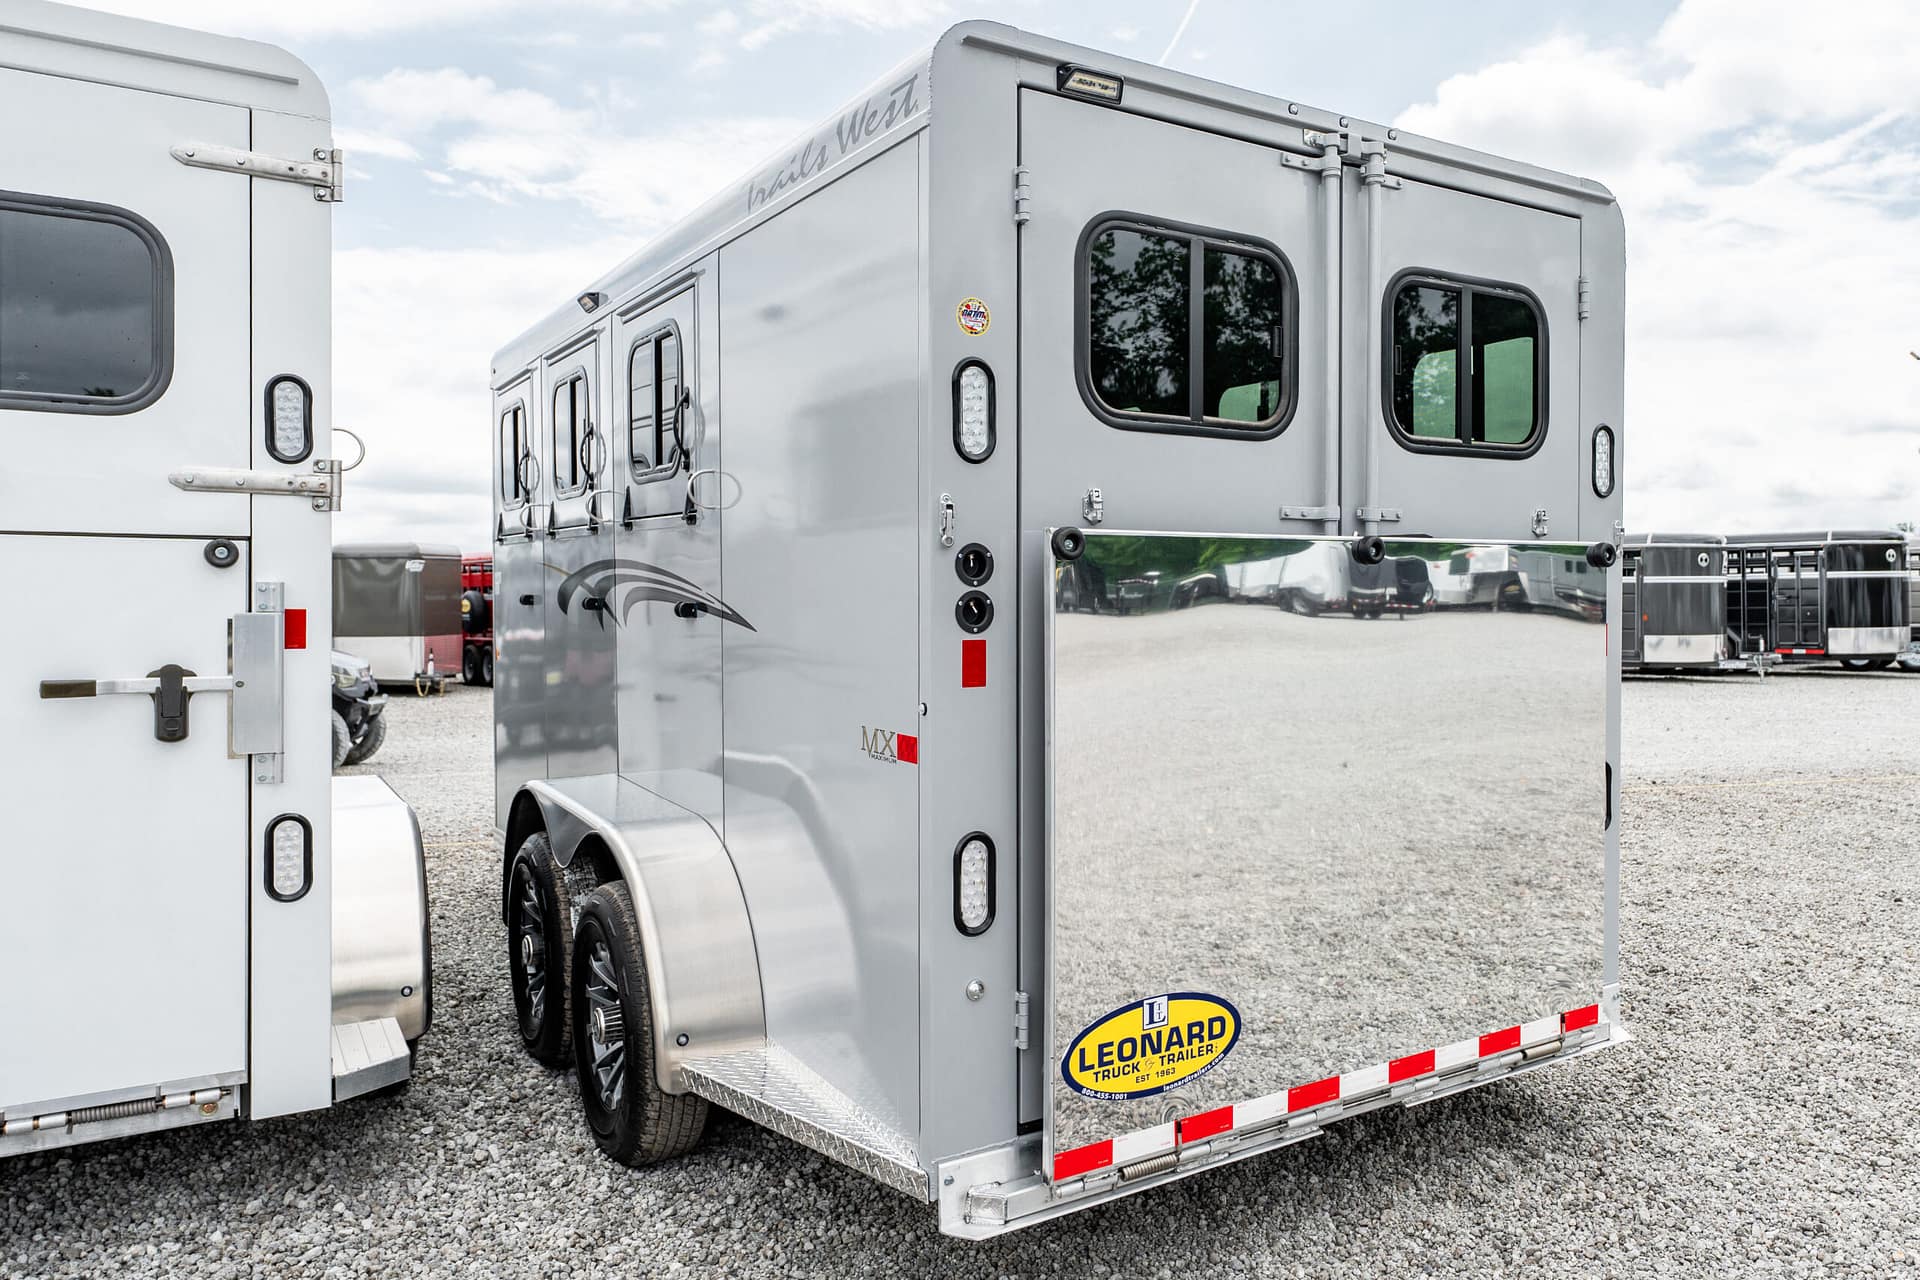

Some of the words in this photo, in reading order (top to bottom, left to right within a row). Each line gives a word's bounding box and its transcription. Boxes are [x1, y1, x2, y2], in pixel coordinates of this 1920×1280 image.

[836, 73, 918, 155] West
[861, 725, 896, 758] MX
[1079, 1015, 1226, 1073] LEONARD
[1093, 1061, 1141, 1083] TRUCK
[1159, 1044, 1214, 1066] TRAILER
[1135, 1073, 1150, 1084] EST
[1155, 1067, 1176, 1079] 1963
